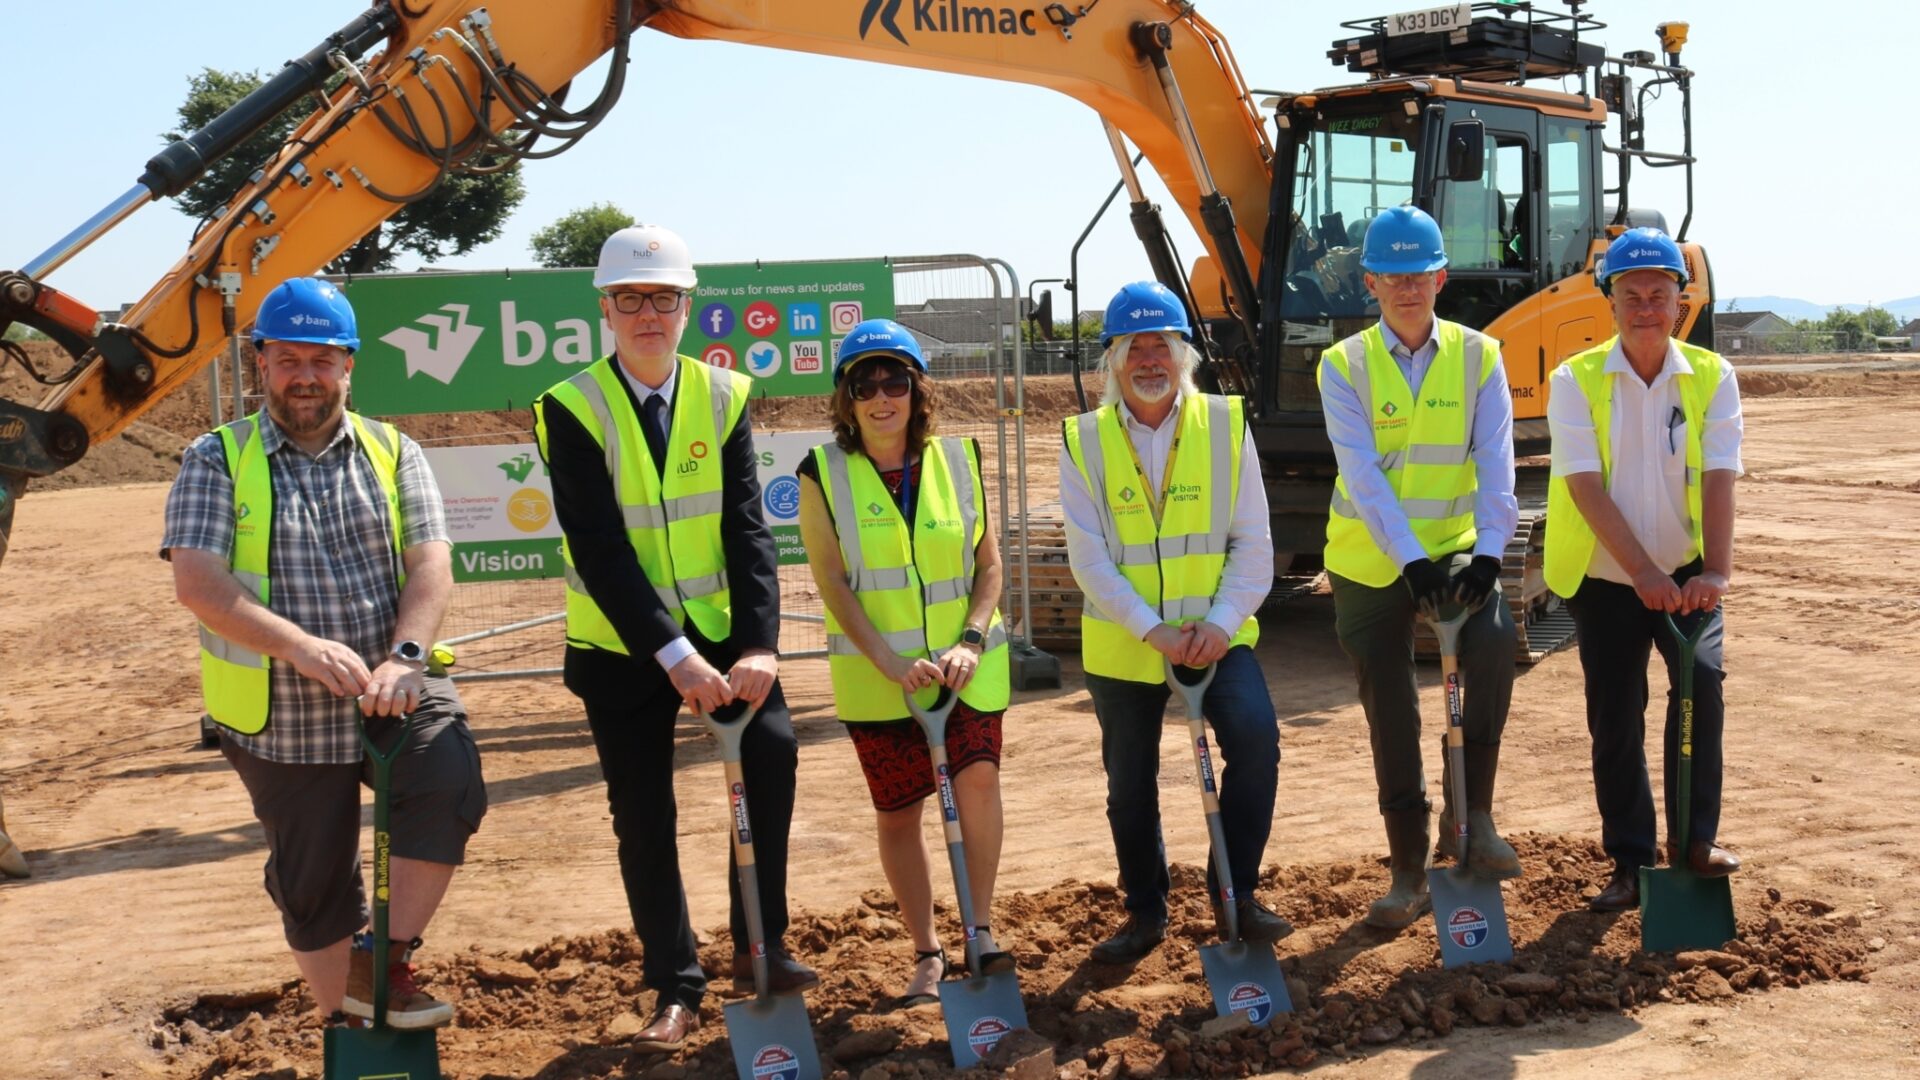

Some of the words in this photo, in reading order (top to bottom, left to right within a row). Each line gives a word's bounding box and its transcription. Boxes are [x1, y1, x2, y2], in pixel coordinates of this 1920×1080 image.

[913, 0, 1036, 36] Kilmac
[1397, 13, 1426, 32] K33
[1430, 7, 1459, 28] DGY
[1328, 119, 1349, 132] WEE
[1402, 242, 1419, 250] bam
[633, 249, 653, 257] hub
[1641, 248, 1661, 257] bam
[696, 286, 728, 297] follow
[731, 287, 745, 296] us
[748, 285, 762, 295] for
[766, 285, 795, 295] news
[797, 282, 818, 293] and
[821, 281, 865, 294] updates
[1143, 308, 1164, 317] bam
[305, 314, 330, 327] bam
[869, 333, 891, 341] bam
[795, 344, 817, 357] You
[796, 359, 819, 370] Tube
[1439, 398, 1459, 408] bam
[1180, 483, 1201, 492] bam
[1172, 494, 1199, 502] VISITOR
[939, 519, 960, 527] bam
[459, 550, 544, 573] Vision
[1682, 712, 1692, 743] Bulldog
[378, 847, 389, 886] Bulldog
